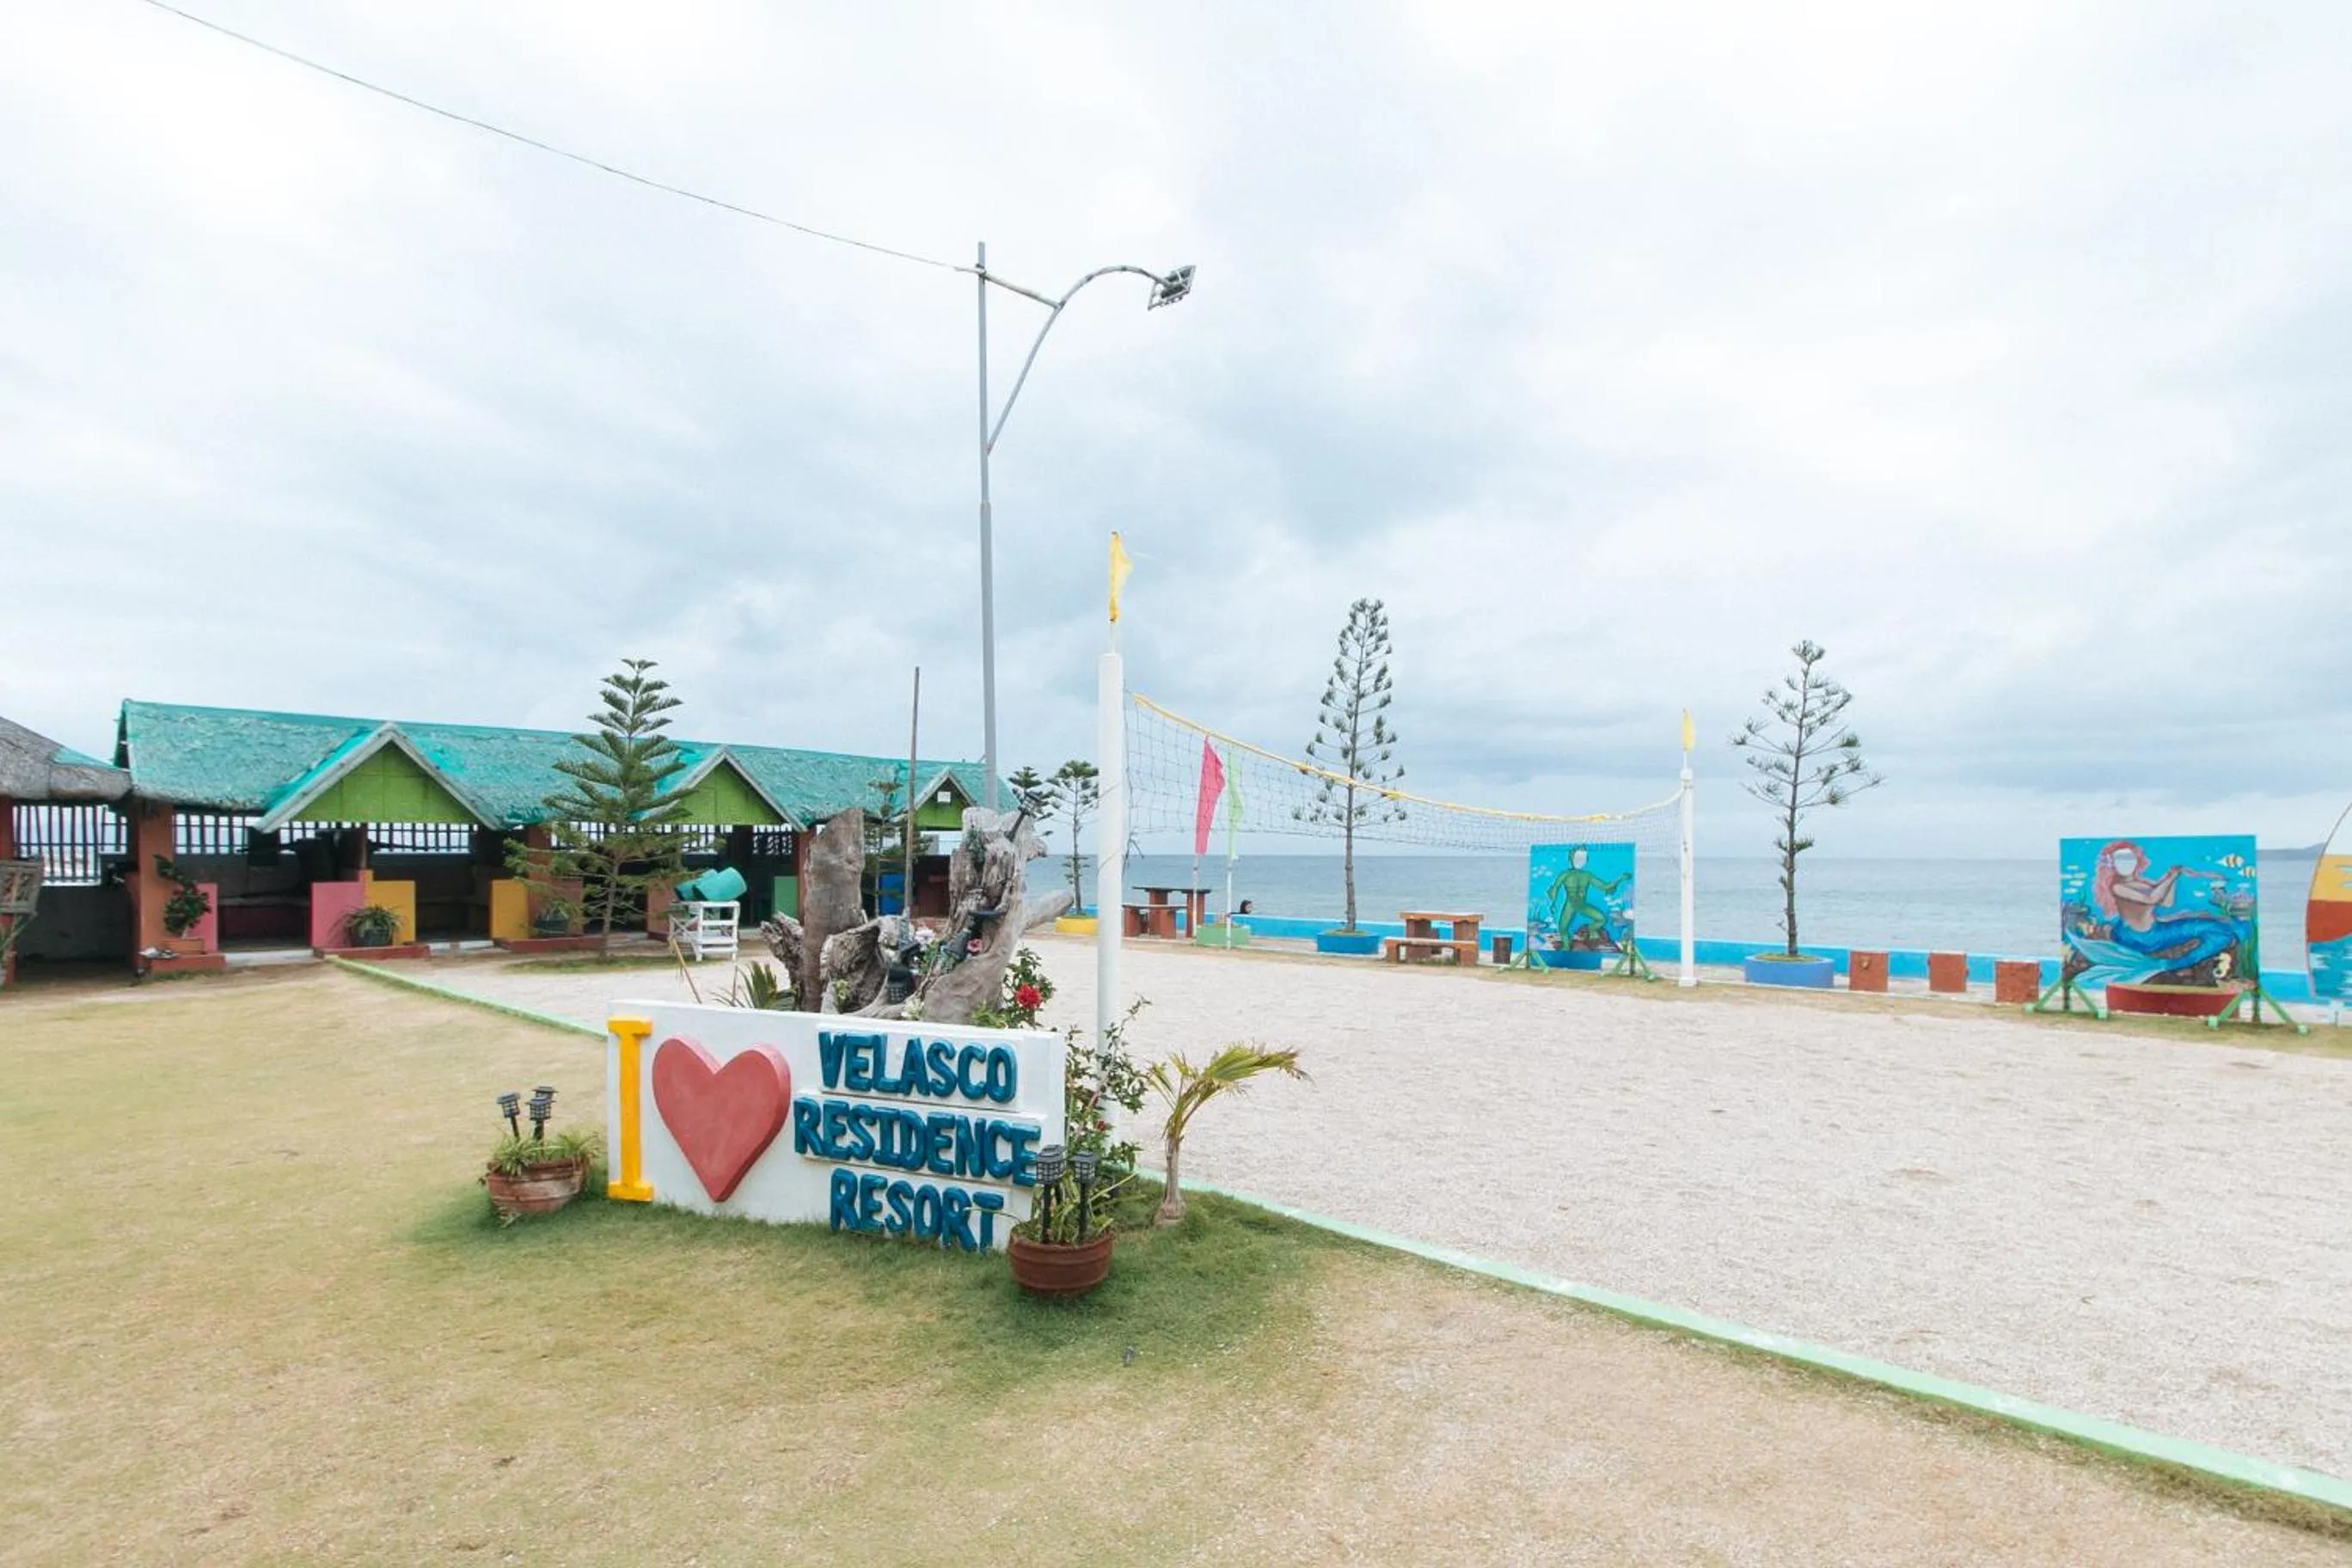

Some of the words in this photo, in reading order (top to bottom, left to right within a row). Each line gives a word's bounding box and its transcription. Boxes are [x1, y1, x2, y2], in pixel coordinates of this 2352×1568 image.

[608, 1016, 653, 1202] I
[818, 1031, 1018, 1103] VELASCO
[793, 1096, 1042, 1187] RESIDENCE
[830, 1167, 1004, 1255] RESORT
